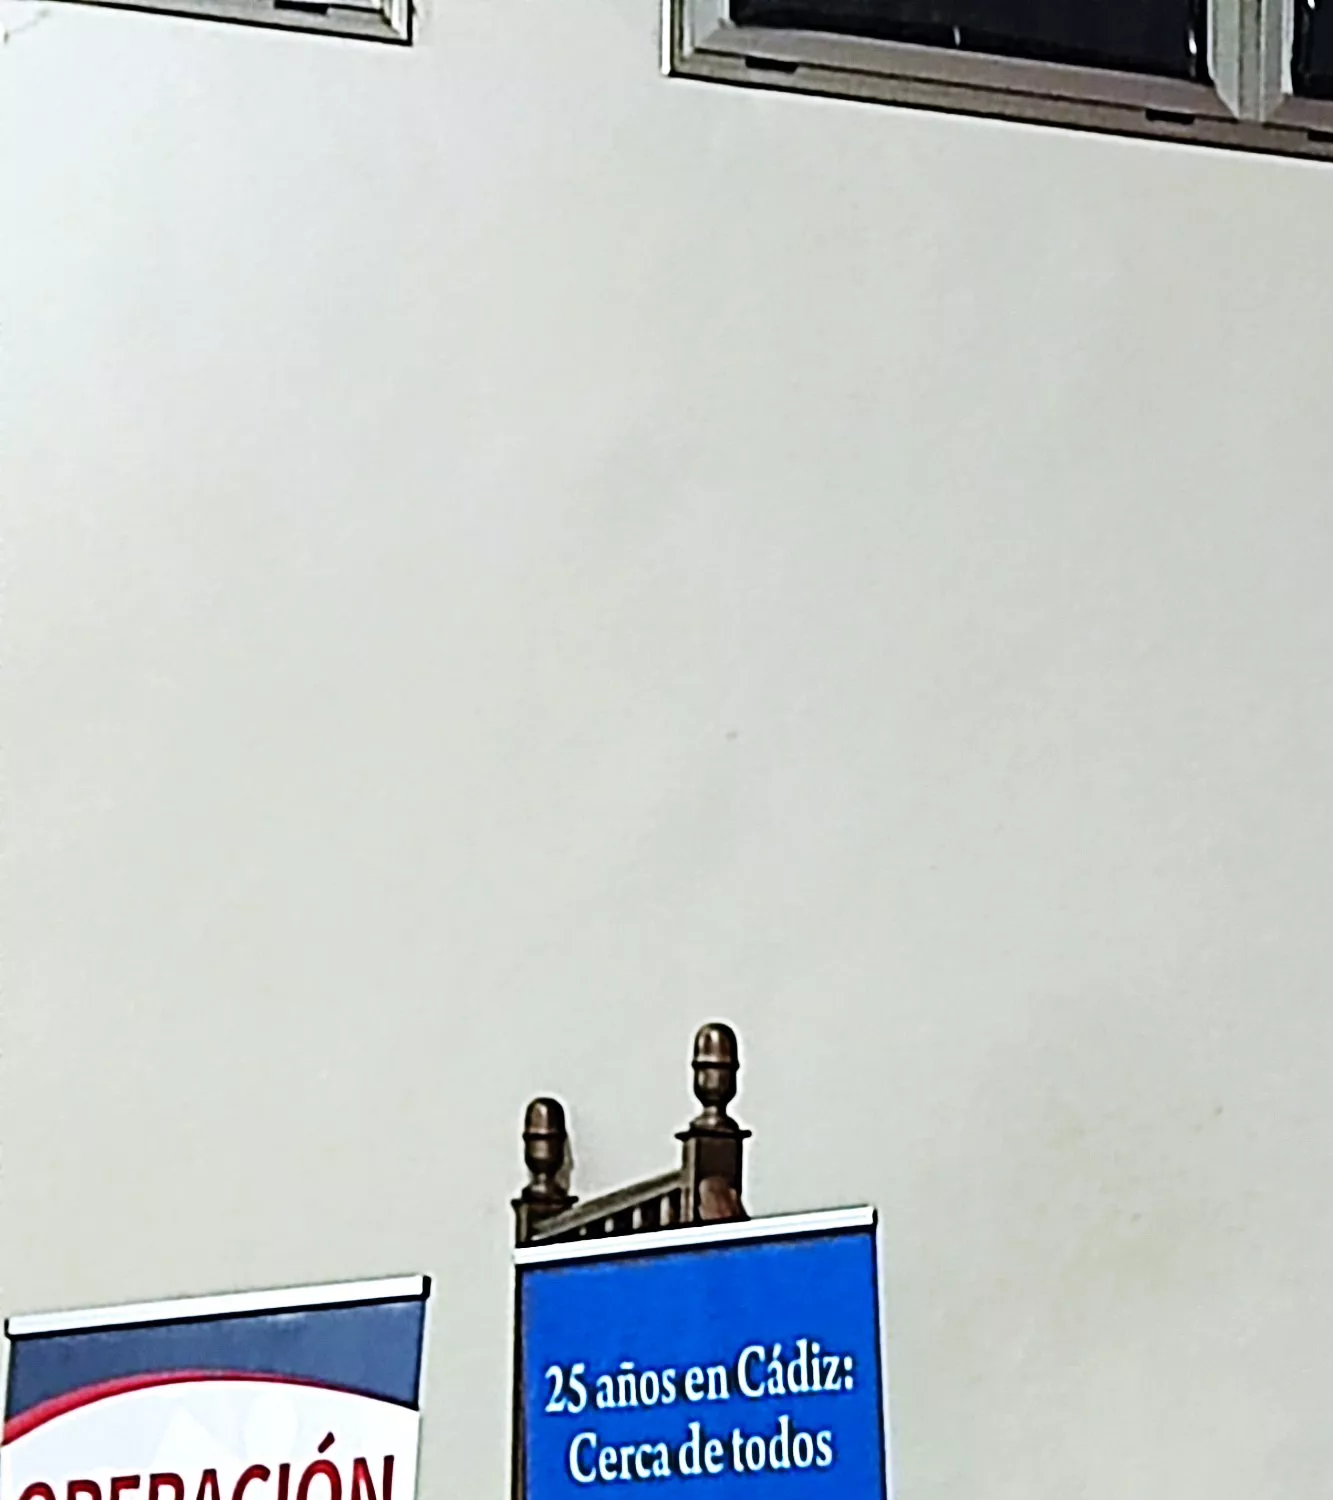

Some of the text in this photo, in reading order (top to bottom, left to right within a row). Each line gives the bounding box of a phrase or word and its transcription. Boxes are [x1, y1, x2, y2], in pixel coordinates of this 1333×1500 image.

[545, 1338, 854, 1413] 25 años en Cádiz:
[569, 1415, 832, 1483] Cerca de todos
